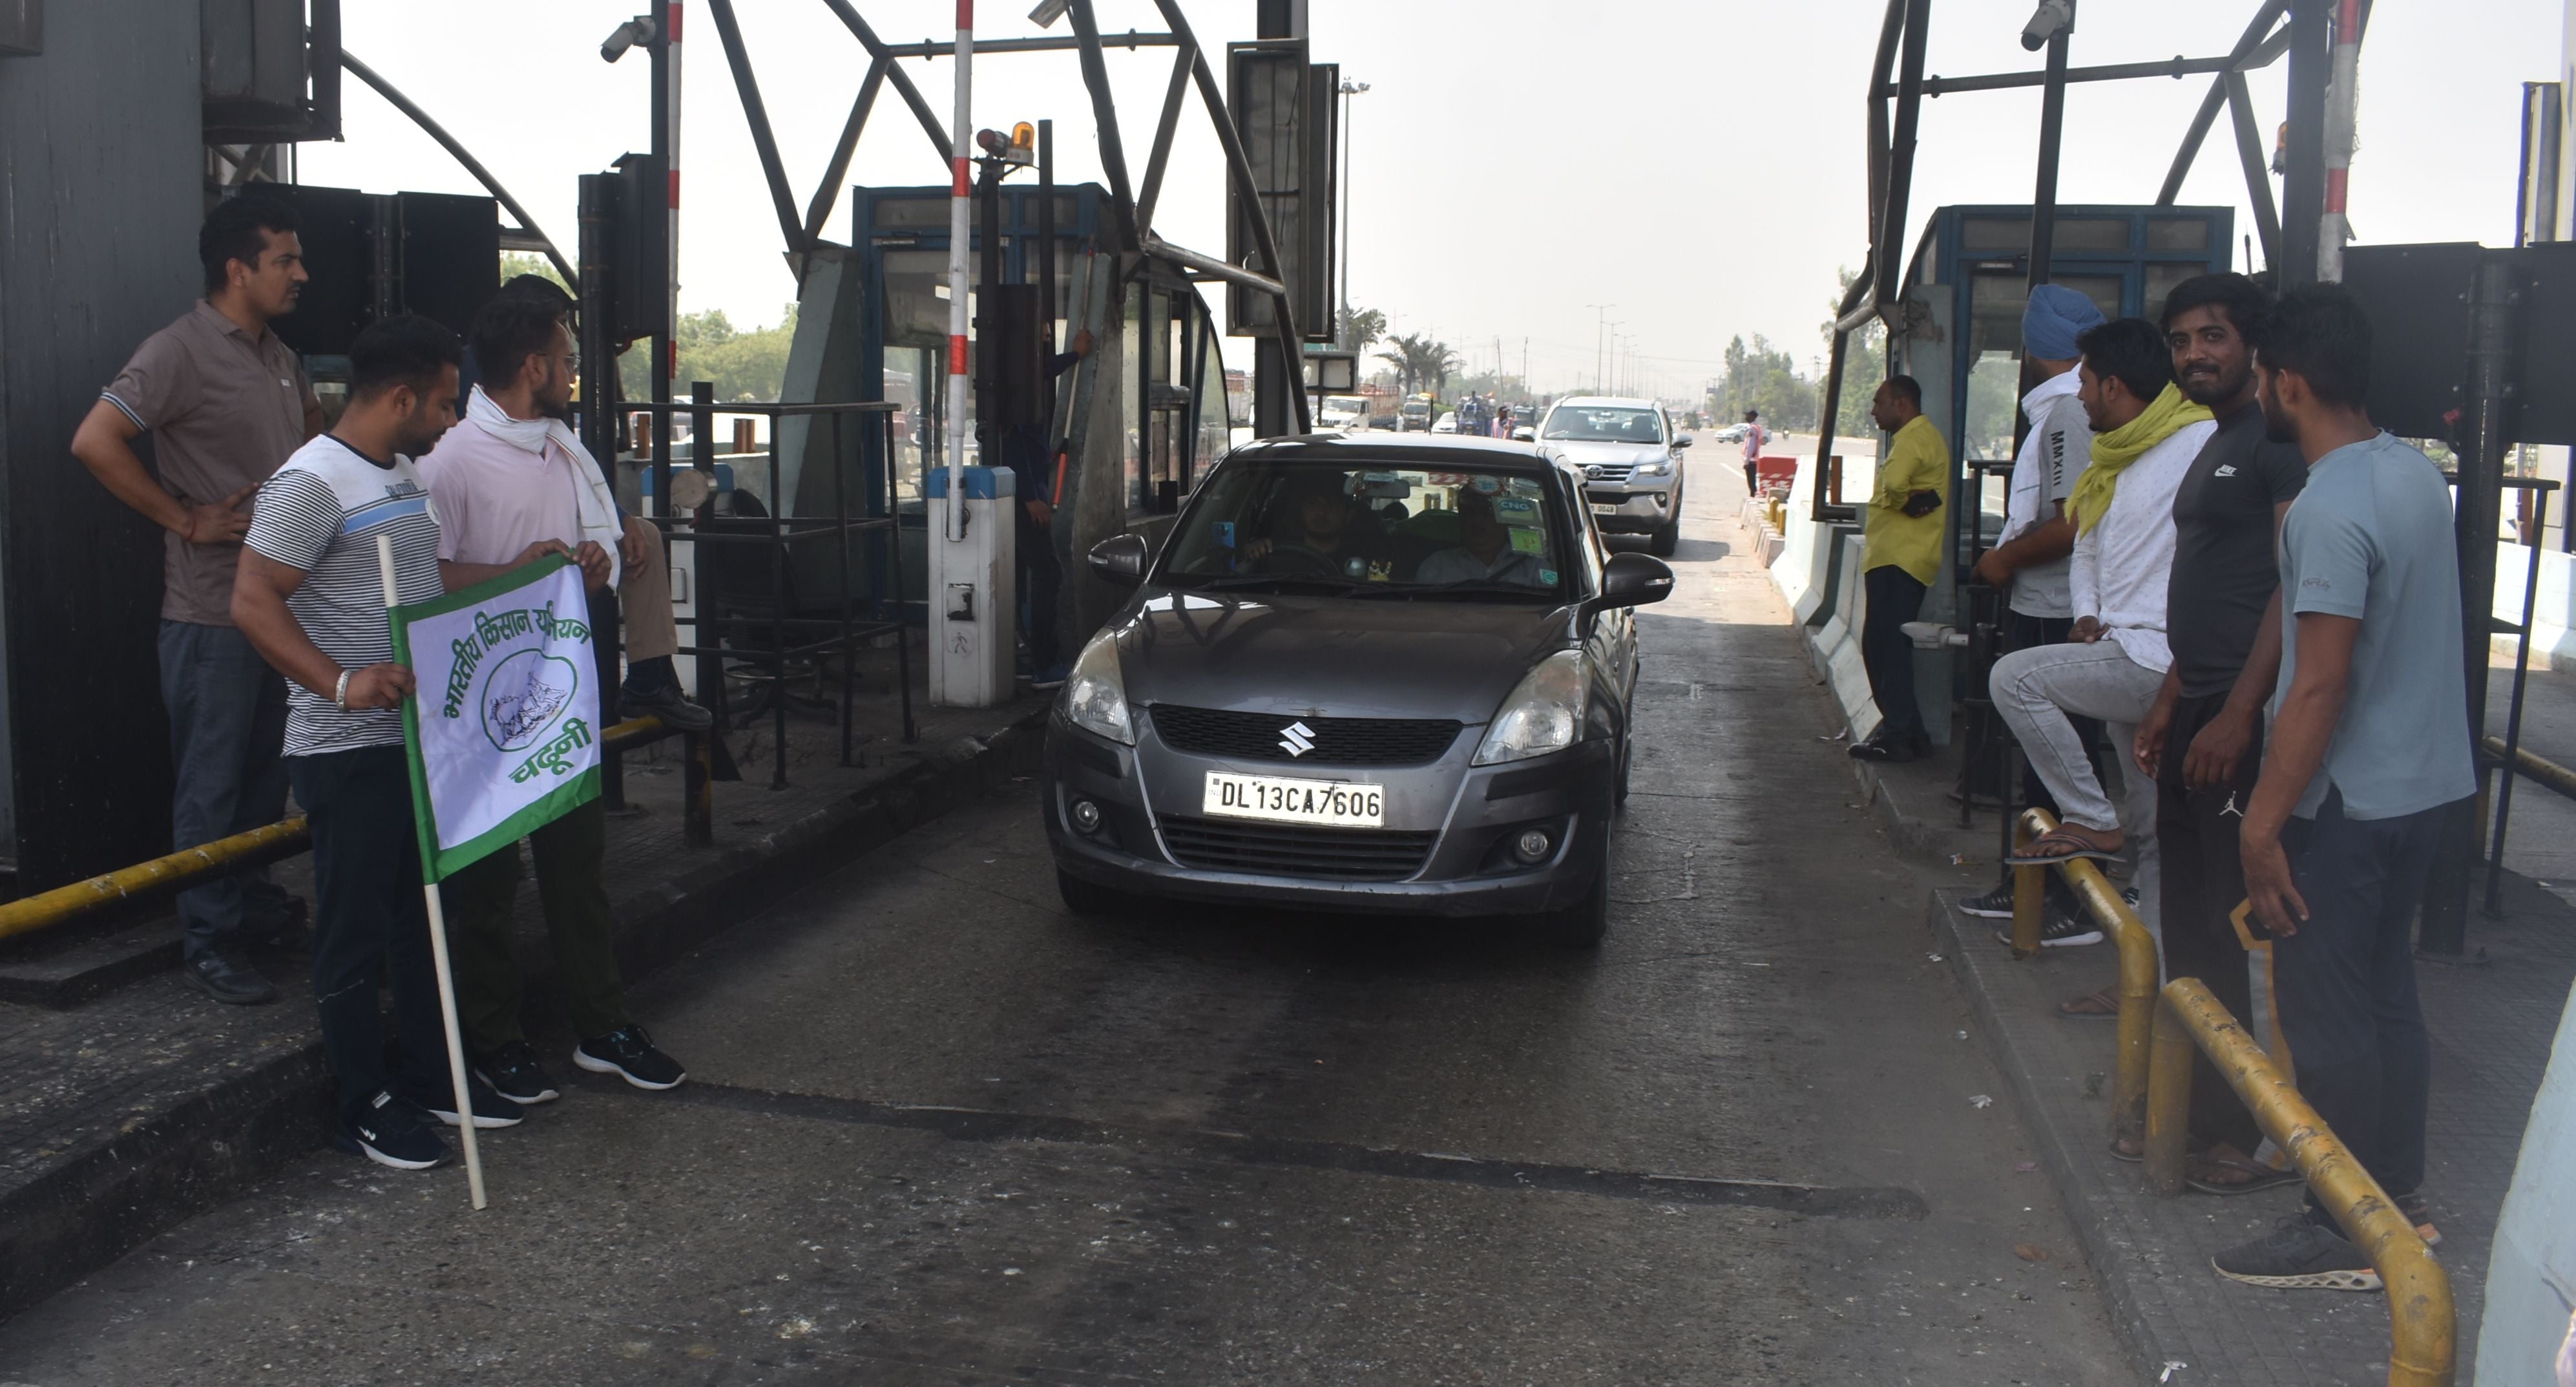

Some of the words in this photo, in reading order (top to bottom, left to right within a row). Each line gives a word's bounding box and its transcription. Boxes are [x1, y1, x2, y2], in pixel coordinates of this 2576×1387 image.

[2051, 430, 2064, 486] MMXIII
[1500, 501, 1531, 511] CNG
[443, 633, 483, 719] भारतीय
[474, 611, 534, 651] किसान
[532, 600, 591, 644] यनियन
[1222, 781, 1379, 816] DL13CA7606
